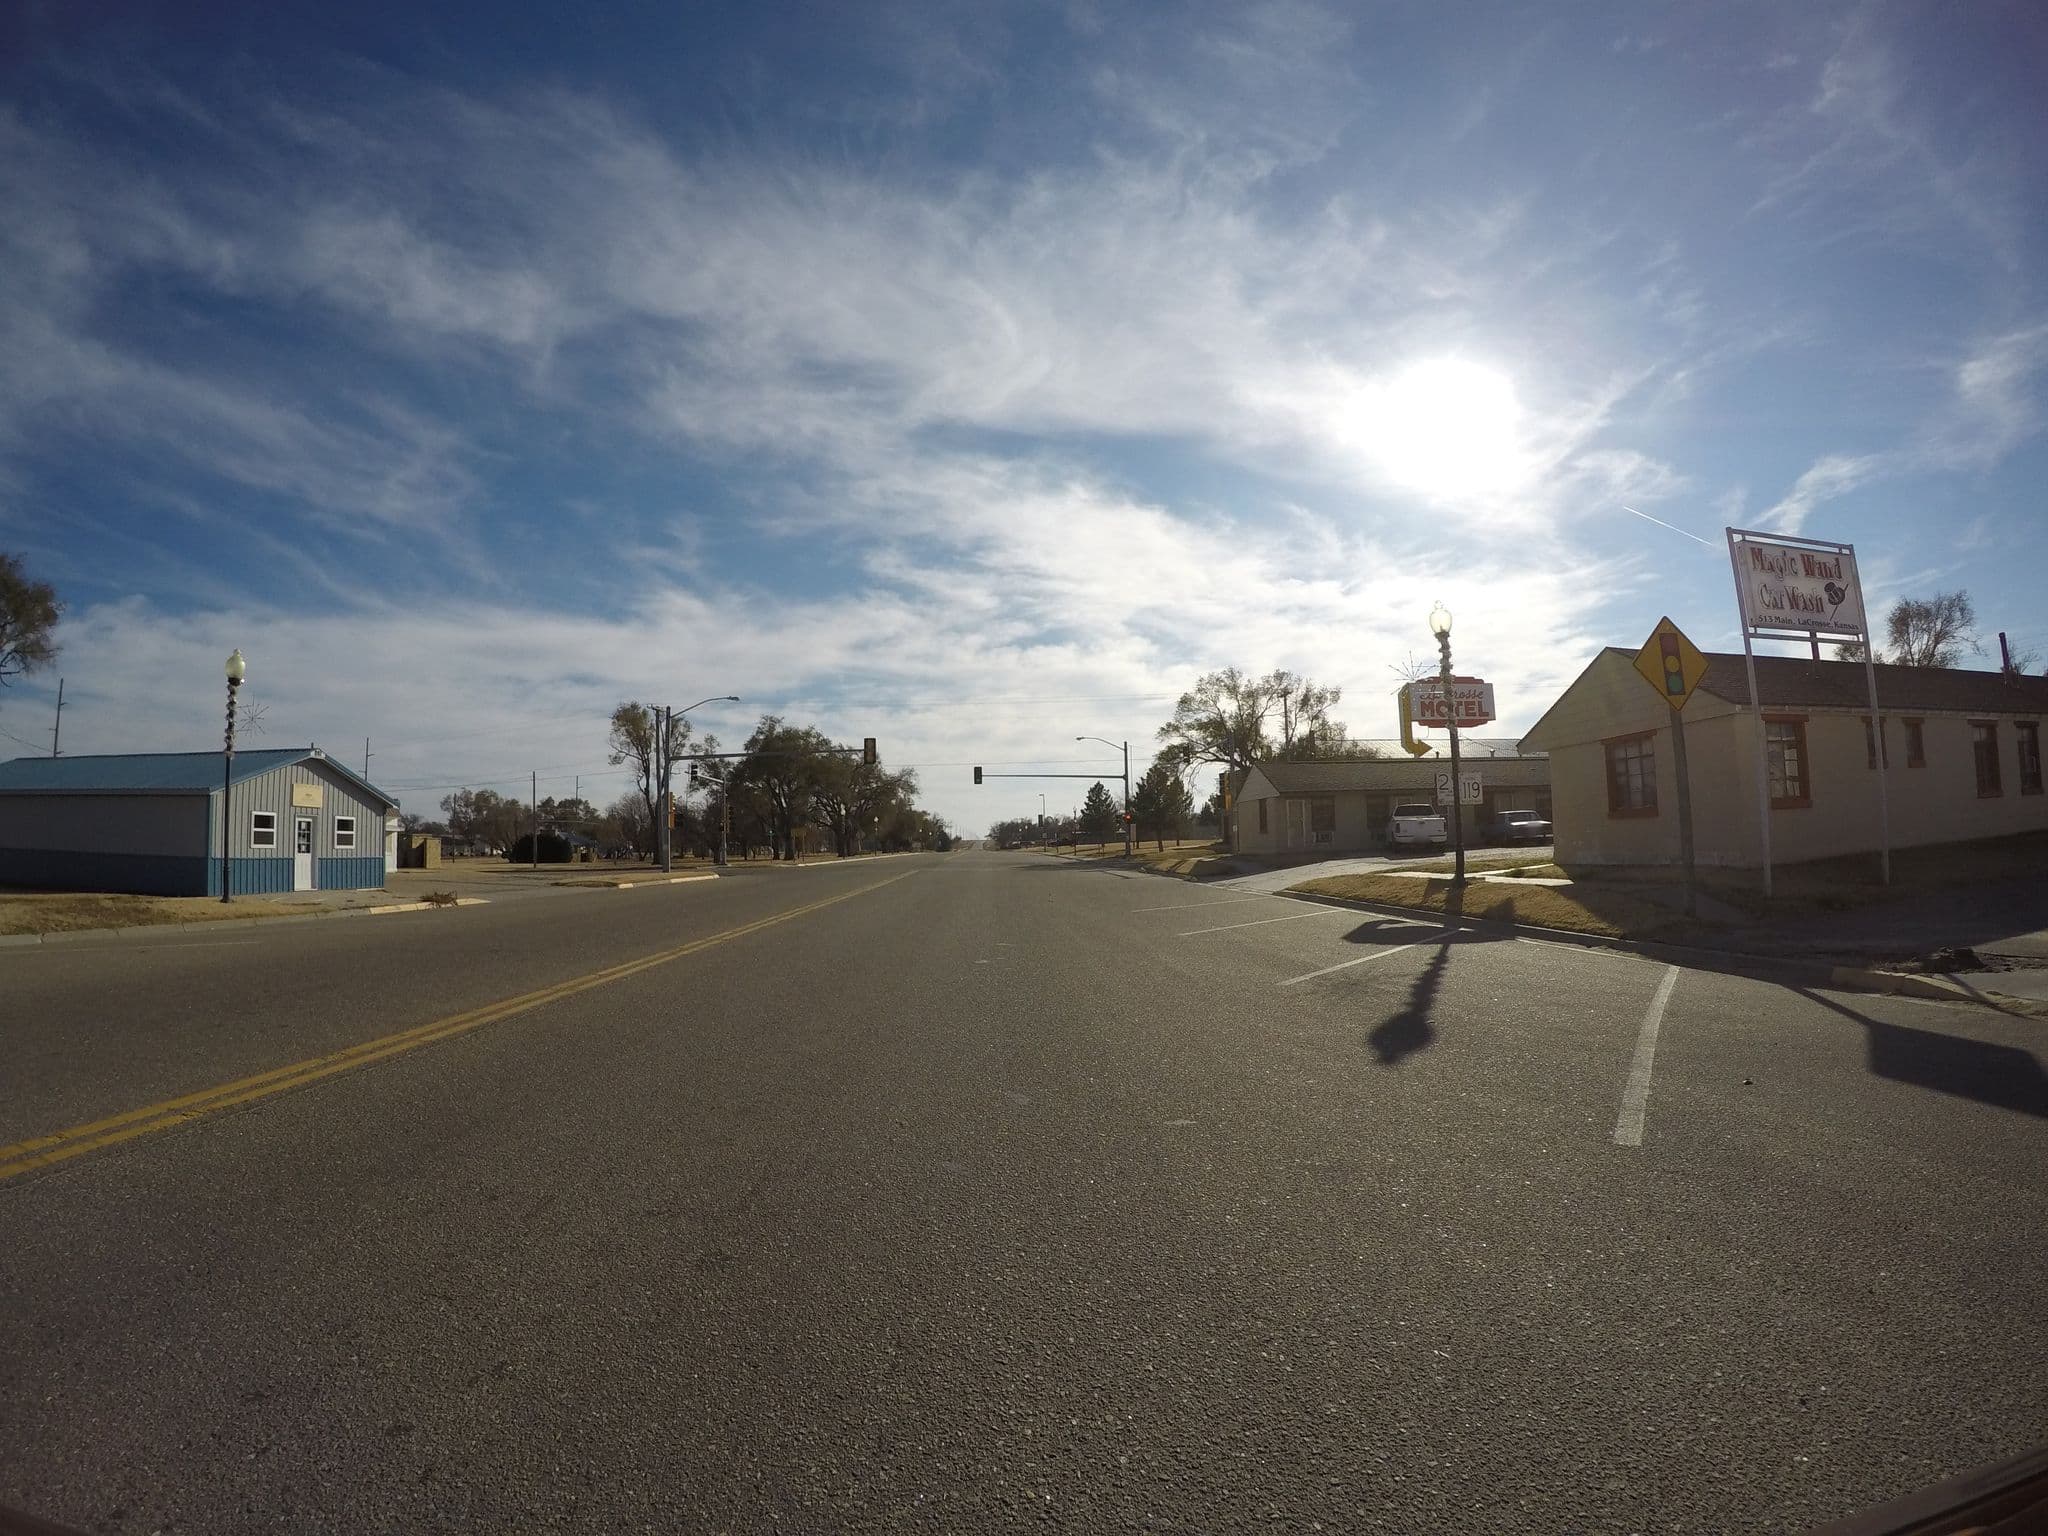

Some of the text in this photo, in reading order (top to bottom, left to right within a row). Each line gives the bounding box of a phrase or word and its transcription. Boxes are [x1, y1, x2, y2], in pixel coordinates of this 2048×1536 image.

[1751, 548, 1842, 580] Magic Wand
[1759, 584, 1825, 613] Car Wash
[1421, 701, 1489, 717] MOTEL
